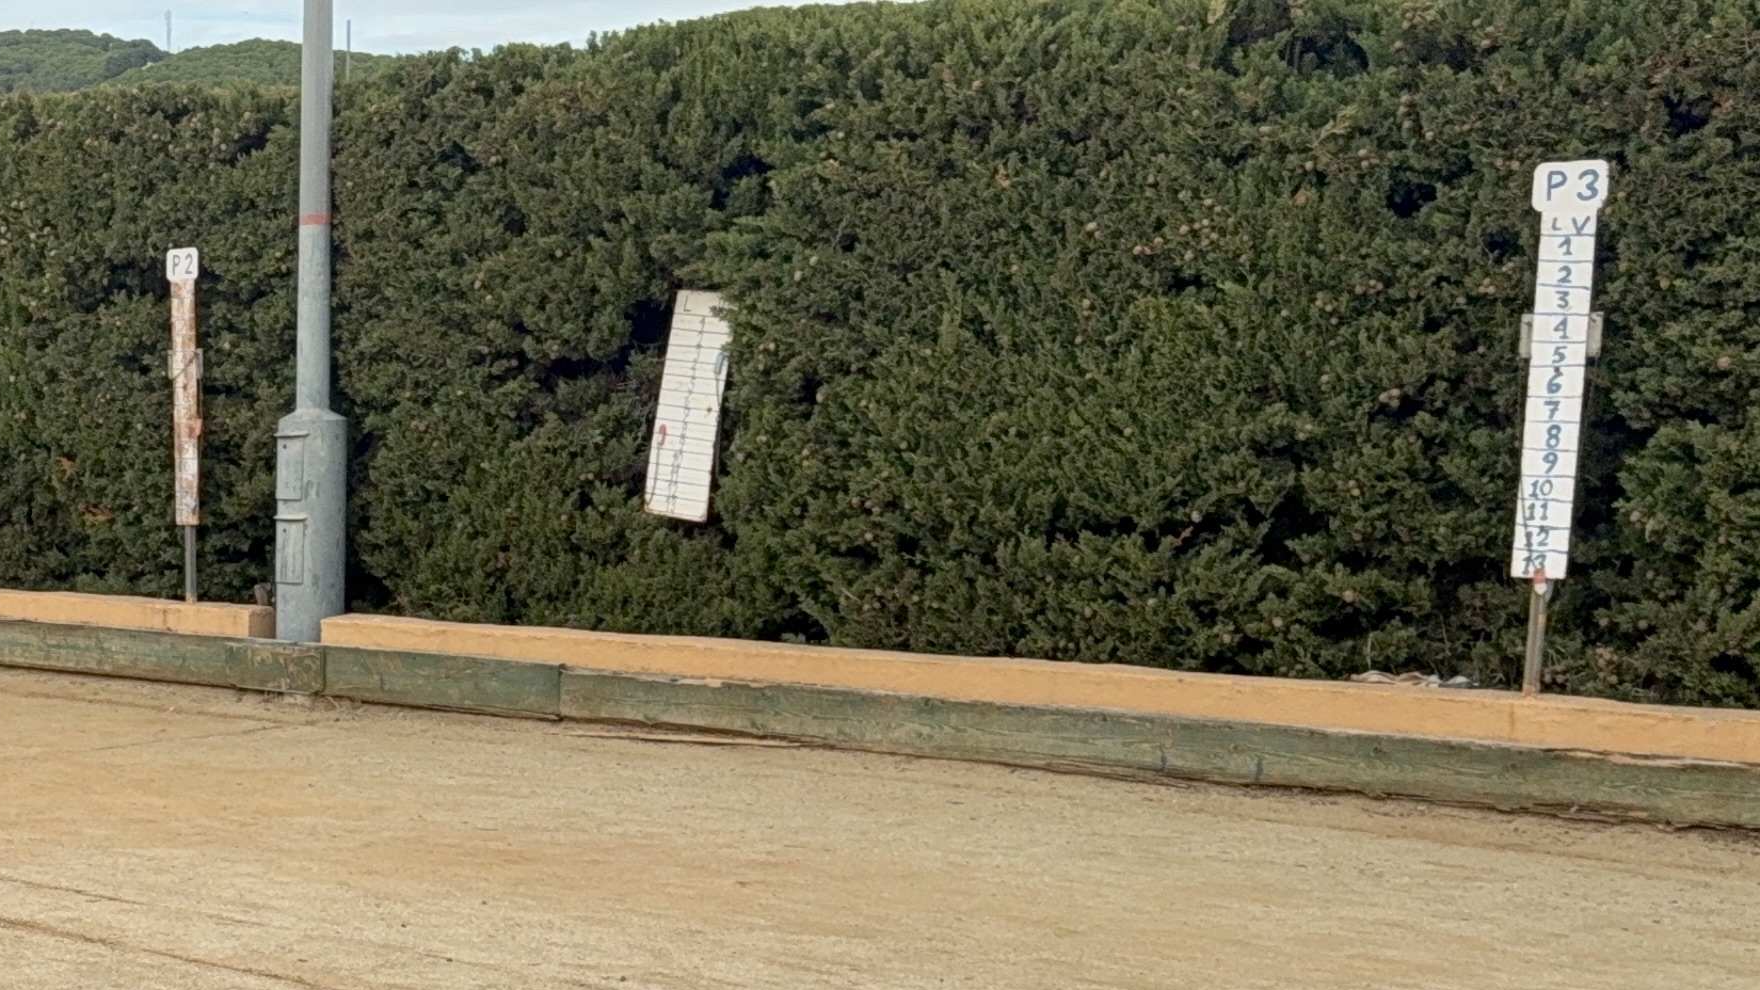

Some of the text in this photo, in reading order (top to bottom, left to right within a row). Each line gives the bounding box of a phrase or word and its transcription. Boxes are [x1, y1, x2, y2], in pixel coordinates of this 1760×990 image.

[1557, 237, 1573, 256] 1
[1557, 265, 1573, 284] 2
[1555, 290, 1570, 309] 3
[1553, 316, 1569, 340] 4
[1551, 346, 1568, 364] 5
[1546, 370, 1564, 394] 6
[1544, 400, 1560, 419] 7
[1546, 424, 1562, 448] 8
[1542, 452, 1559, 474] 9
[1529, 479, 1553, 498] 10
[1526, 502, 1549, 521] 11
[1524, 525, 1550, 547] 12
